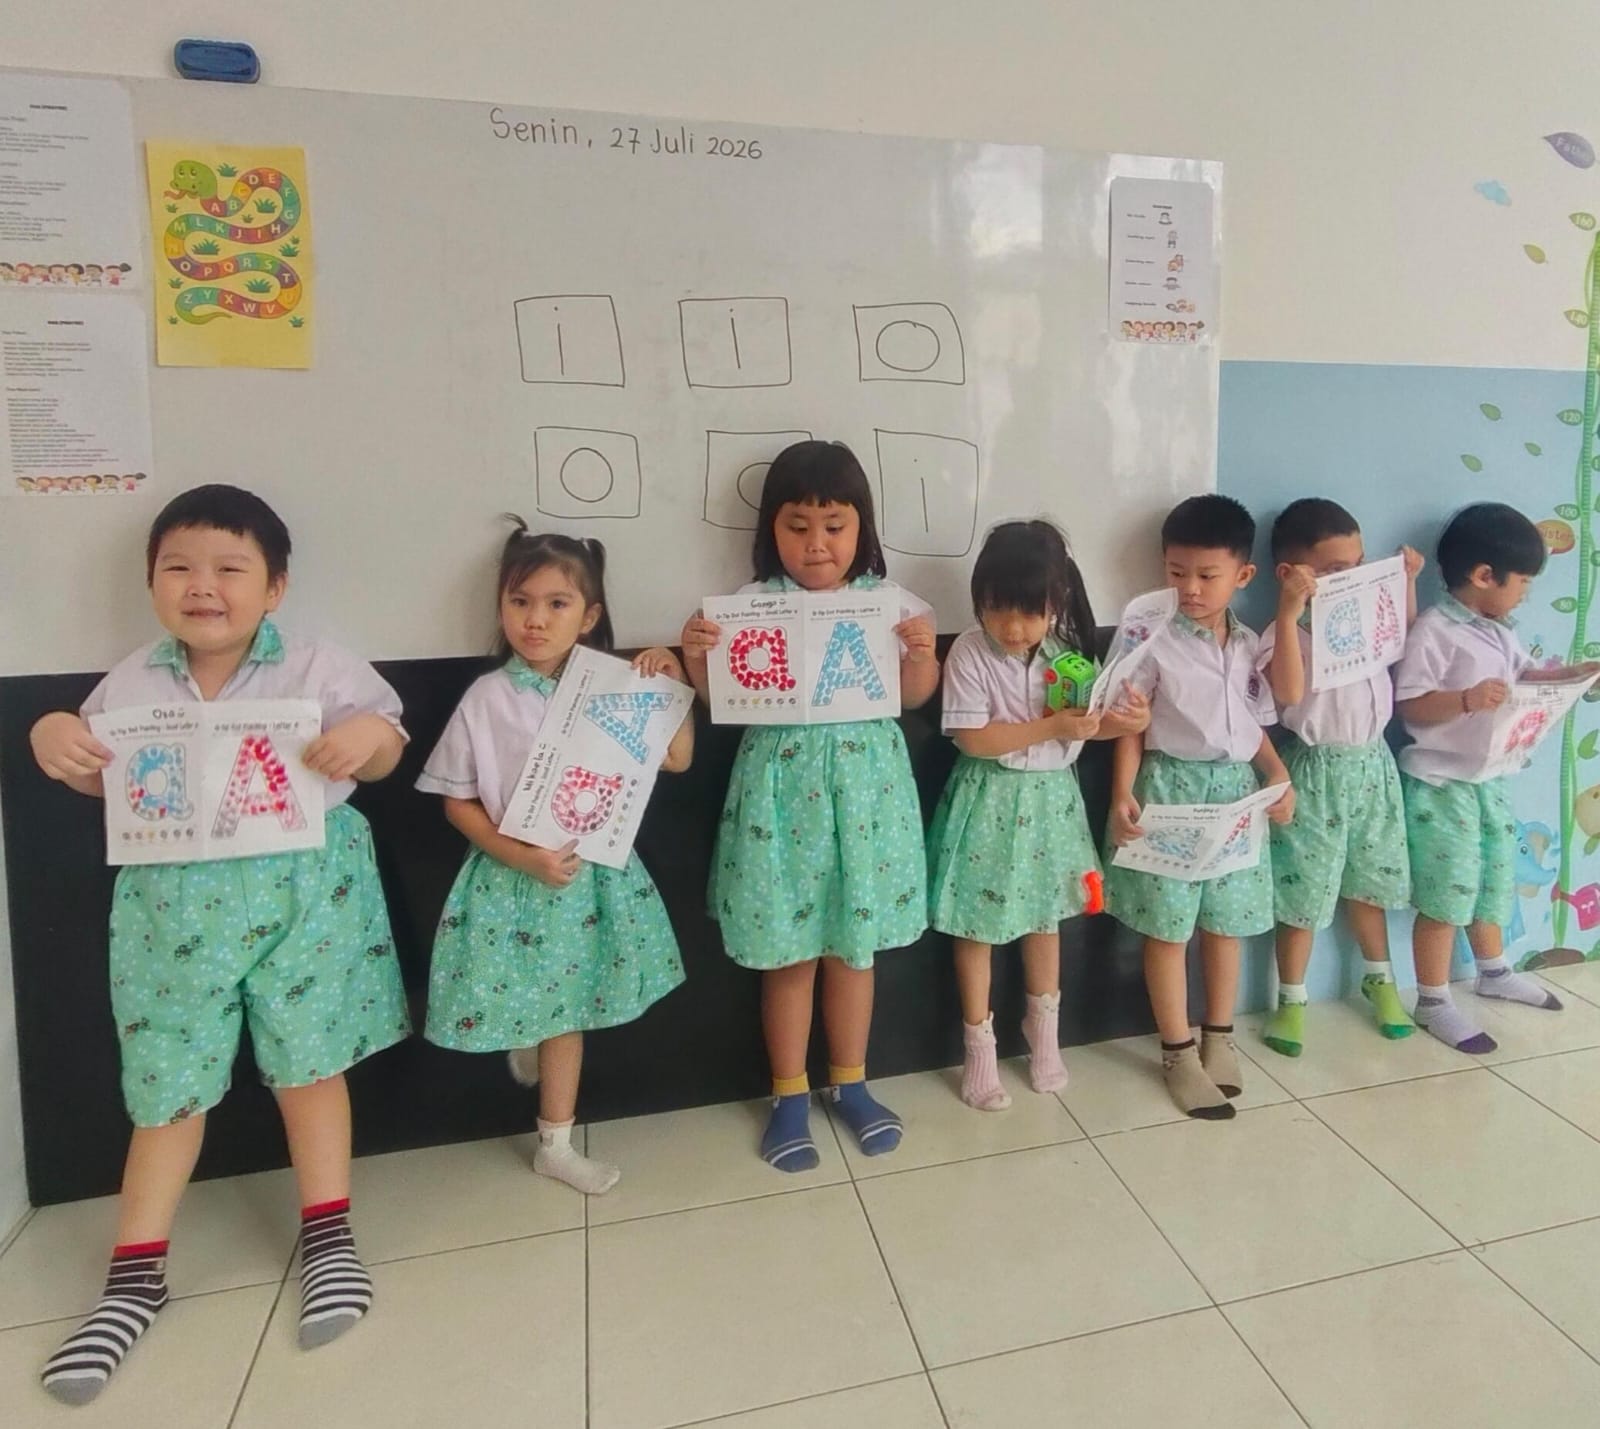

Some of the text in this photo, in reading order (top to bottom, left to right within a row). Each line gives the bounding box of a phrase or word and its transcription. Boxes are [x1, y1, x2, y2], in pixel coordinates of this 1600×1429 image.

[489, 107, 763, 160] Senin, 27 Juli 2026
[249, 174, 259, 185] D
[268, 174, 276, 184] E
[284, 188, 292, 197] F
[211, 203, 220, 213] A
[229, 200, 238, 209] B
[284, 209, 294, 219] G
[174, 221, 186, 232] M
[196, 218, 204, 227] L
[216, 223, 225, 232] K
[236, 229, 242, 239] J
[257, 229, 262, 239] I
[271, 224, 280, 234] H
[180, 257, 291, 283] O P Q R S T
[184, 294, 193, 304] Z
[204, 289, 213, 299] Y
[224, 294, 234, 304] X
[243, 302, 256, 313] W
[266, 304, 276, 314] V
[552, 305, 565, 376] i
[728, 307, 741, 370] i
[1560, 506, 1577, 517] 100
